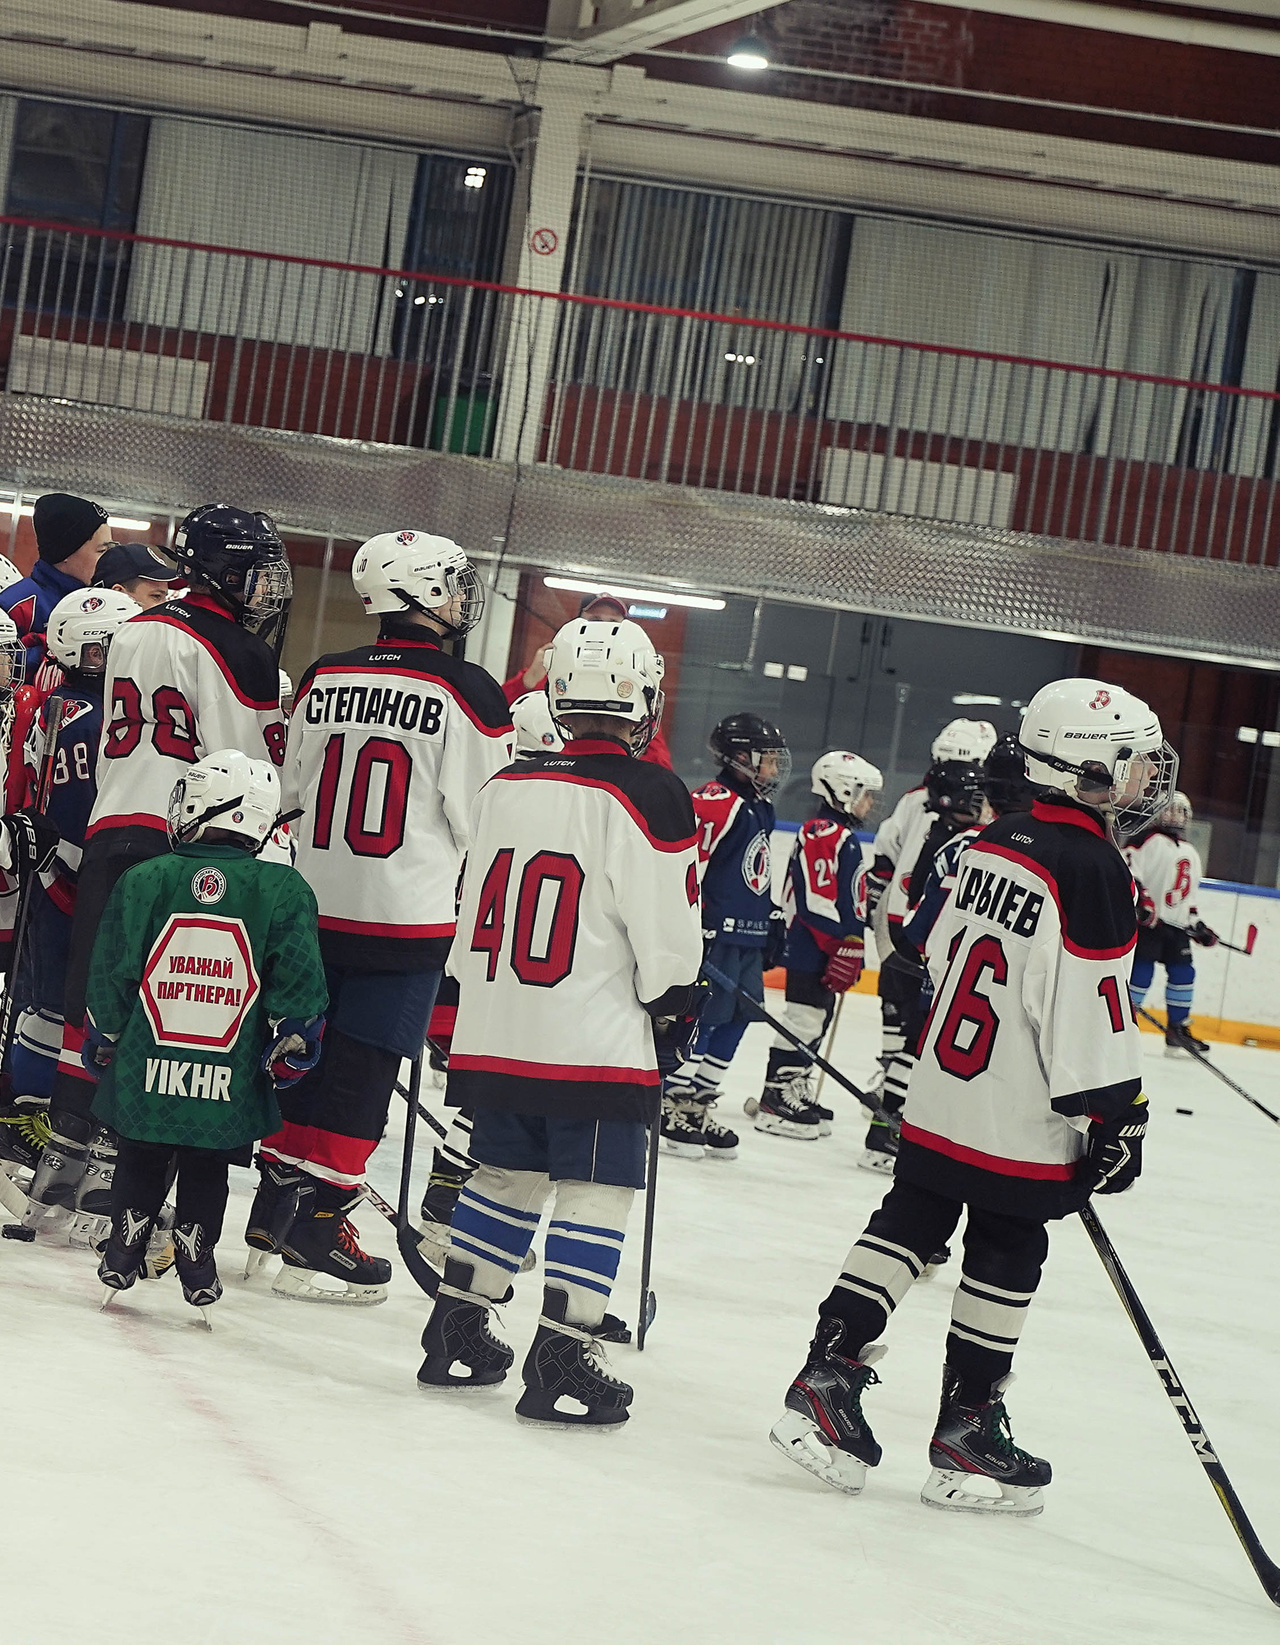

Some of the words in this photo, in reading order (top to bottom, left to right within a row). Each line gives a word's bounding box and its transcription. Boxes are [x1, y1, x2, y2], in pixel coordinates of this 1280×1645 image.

[413, 564, 436, 573] BAUER
[165, 604, 191, 618] LUTCH
[305, 686, 444, 735] СТЕПАНОВ
[1064, 731, 1108, 740] BAUER
[312, 732, 413, 859] 10
[1011, 832, 1035, 845] LUTCH
[470, 848, 586, 988] 40
[169, 956, 233, 979] УВАЖАЙ
[157, 982, 242, 1006] ПАРТНЕРА!
[916, 925, 1009, 1082] 16
[145, 1058, 231, 1102] VIKHR
[838, 1407, 856, 1431] BAUER
[1151, 1355, 1218, 1463] CCM
[984, 1453, 1009, 1470] BAUER
